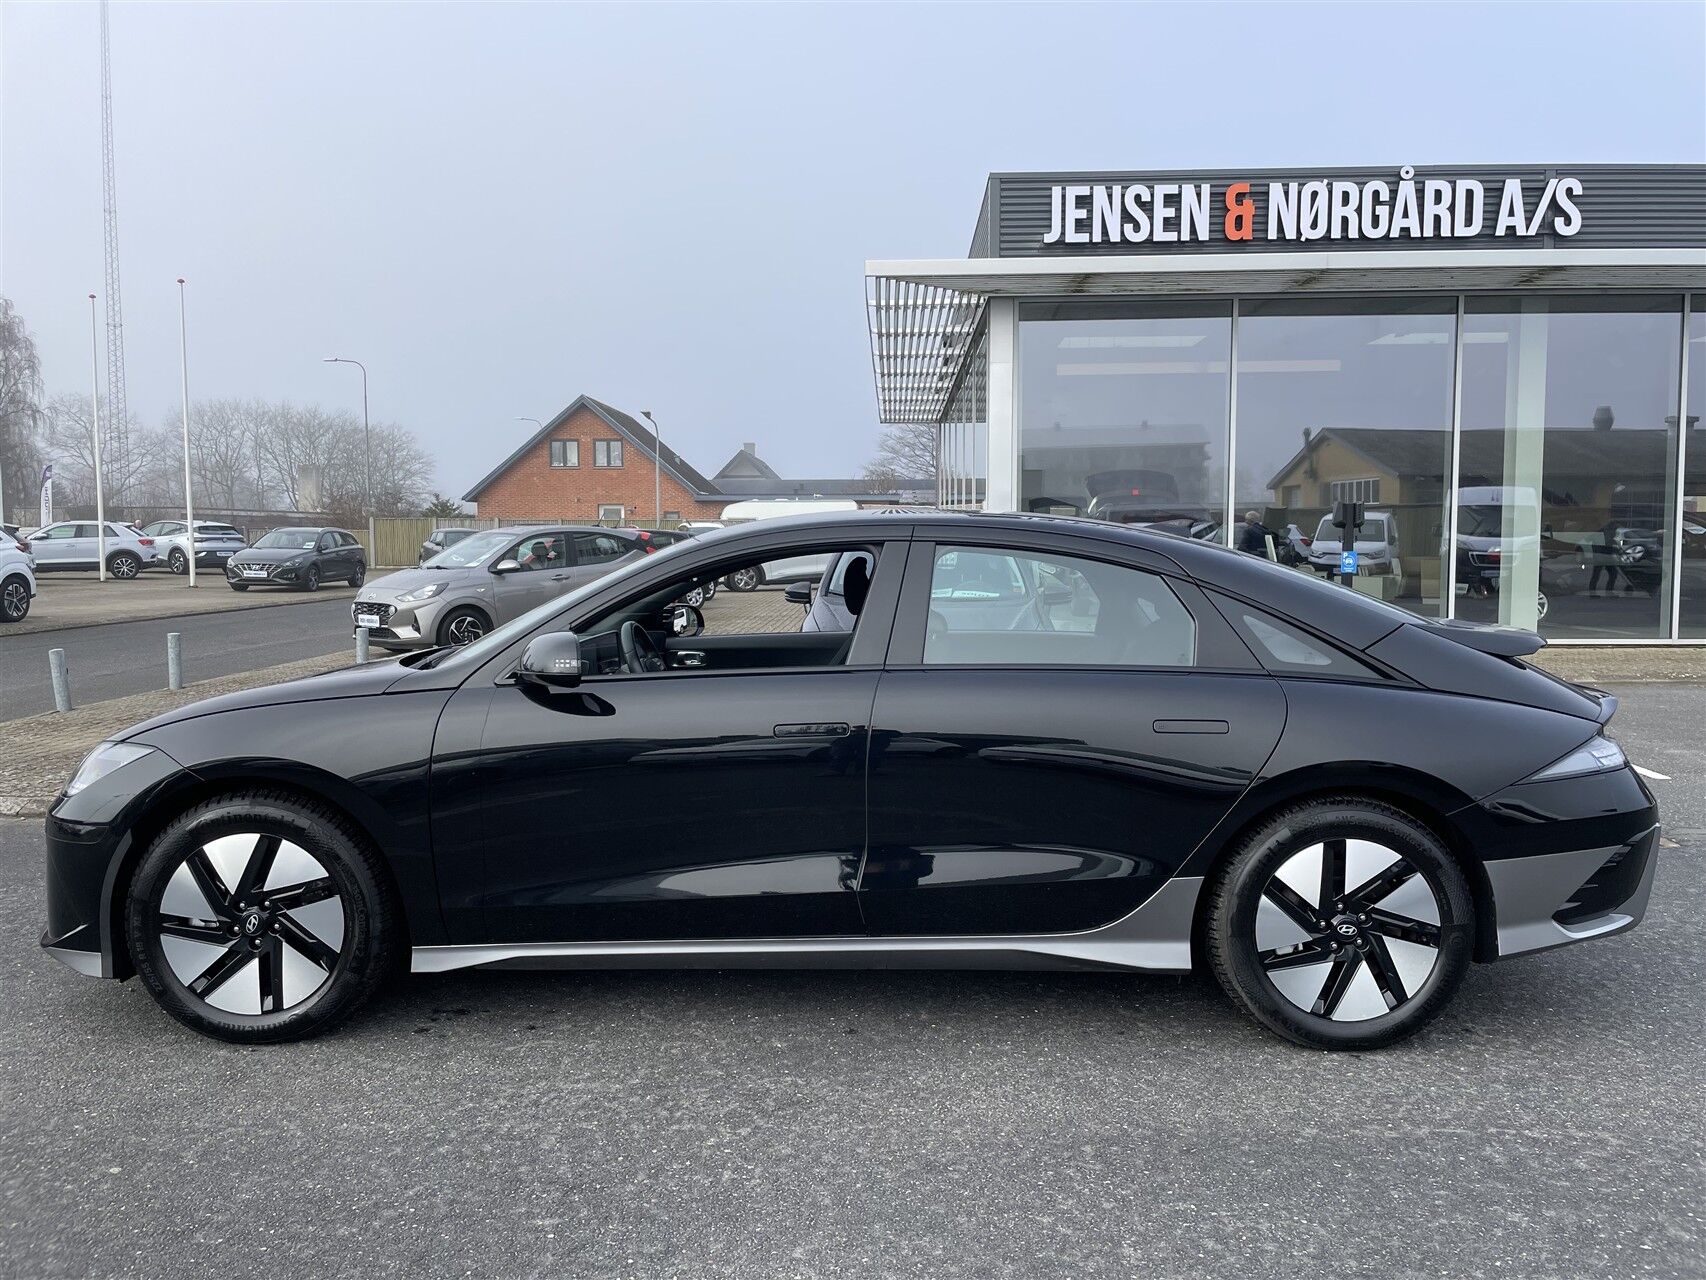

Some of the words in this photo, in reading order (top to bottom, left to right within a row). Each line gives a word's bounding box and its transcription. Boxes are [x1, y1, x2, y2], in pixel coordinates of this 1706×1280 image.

[1043, 184, 1210, 244] JENSEN
[1224, 183, 1254, 241] &
[1267, 166, 1484, 242] NØRGÅRD
[1495, 178, 1583, 237] A/S
